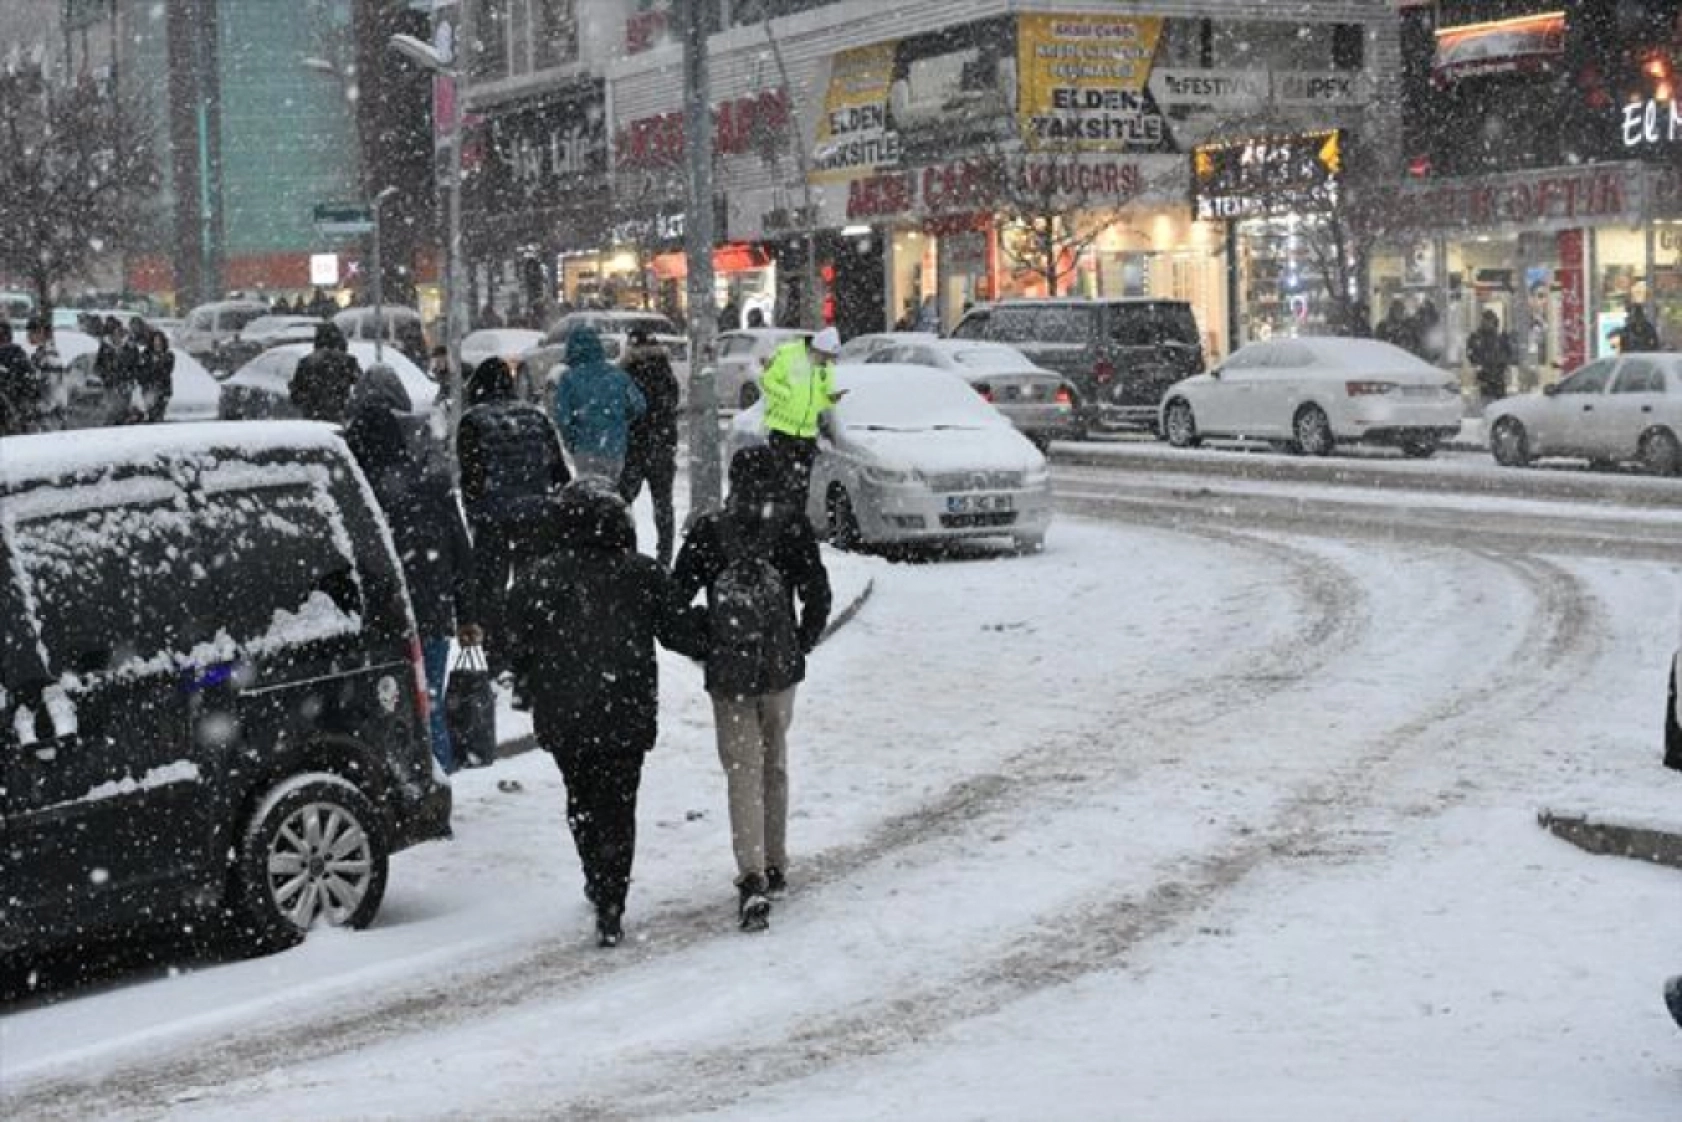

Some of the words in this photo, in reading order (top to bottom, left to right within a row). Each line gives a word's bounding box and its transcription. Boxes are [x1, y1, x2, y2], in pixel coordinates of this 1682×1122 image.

[1052, 87, 1138, 110] ELDEN
[828, 103, 884, 135] ELDEN
[1030, 113, 1160, 139] TAKSİTLE
